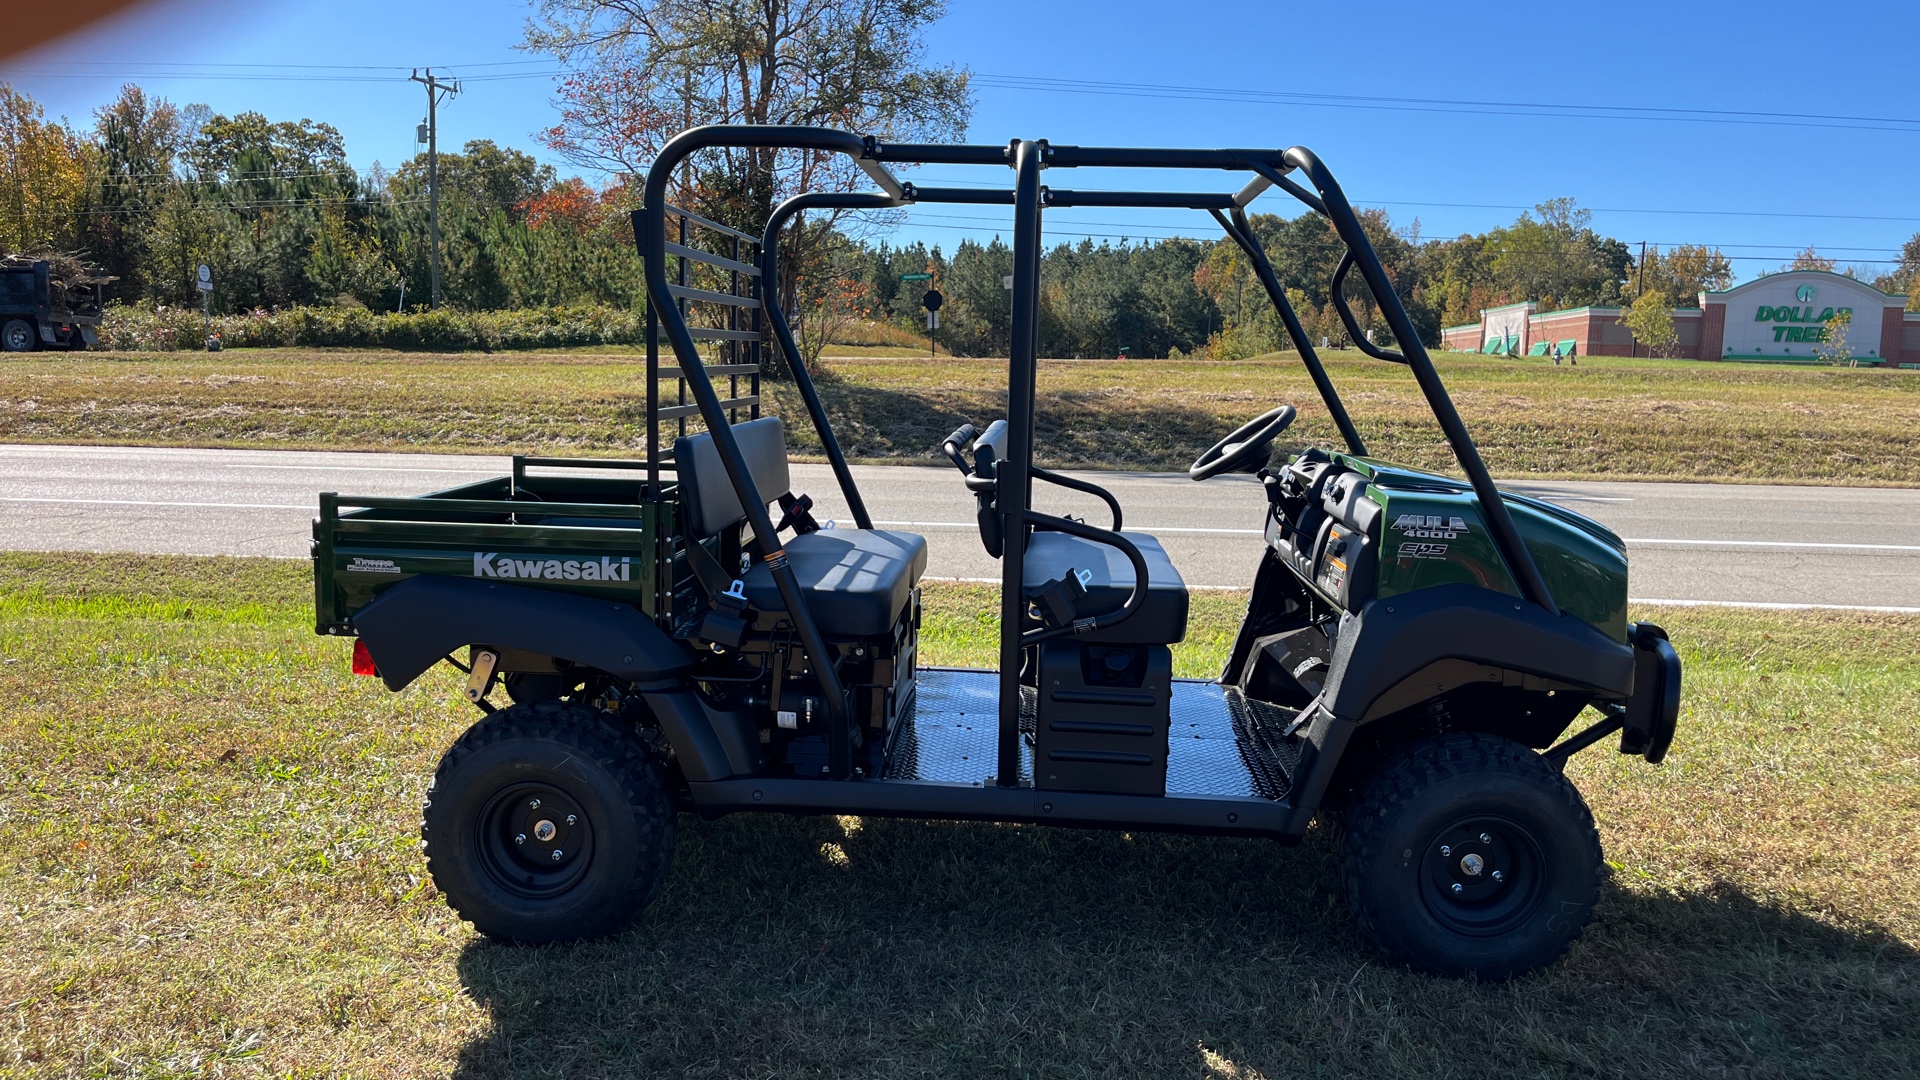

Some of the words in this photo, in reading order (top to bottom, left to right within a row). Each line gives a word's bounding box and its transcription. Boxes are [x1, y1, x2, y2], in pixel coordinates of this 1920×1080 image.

[1390, 514, 1471, 533] MULE
[1402, 530, 1457, 540] 4000
[473, 551, 631, 582] Kawasaki
